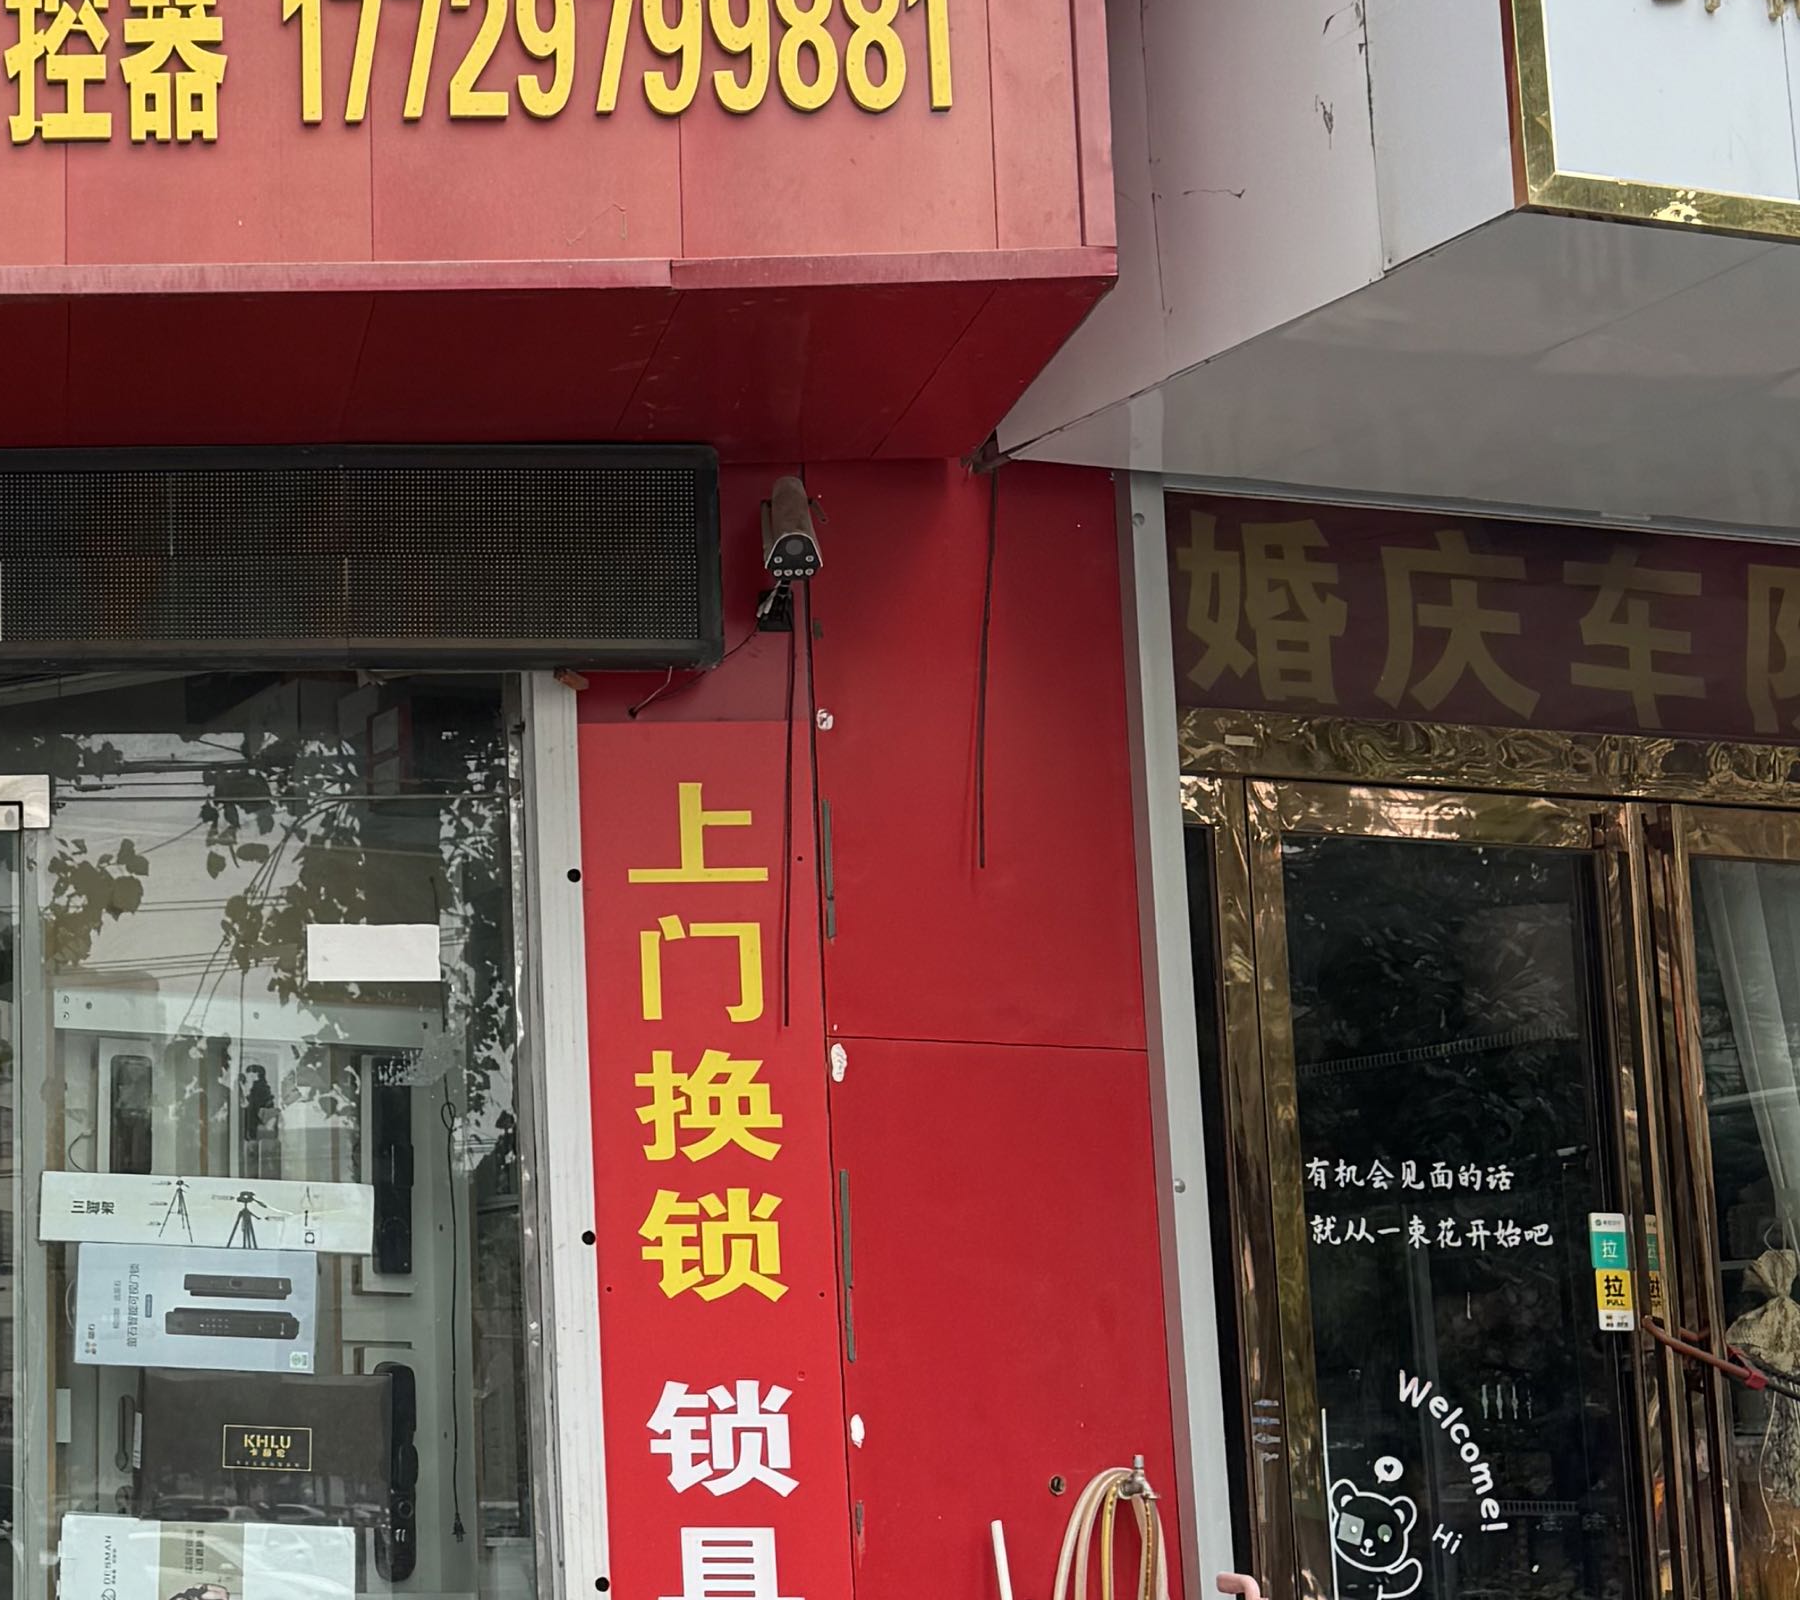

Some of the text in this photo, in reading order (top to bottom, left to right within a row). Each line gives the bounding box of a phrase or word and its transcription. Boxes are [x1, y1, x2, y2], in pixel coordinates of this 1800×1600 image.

[628, 782, 788, 1302] 上门换锁
[1305, 1156, 1515, 1192] 有机会见面的话
[1309, 1214, 1554, 1251] 就从一束花开始吧
[1604, 1274, 1626, 1298] 拉
[1606, 1299, 1626, 1307] PULL
[243, 1433, 291, 1449] KHLU
[1399, 1369, 1509, 1533] Welcome!
[1432, 1523, 1463, 1555] Hi
